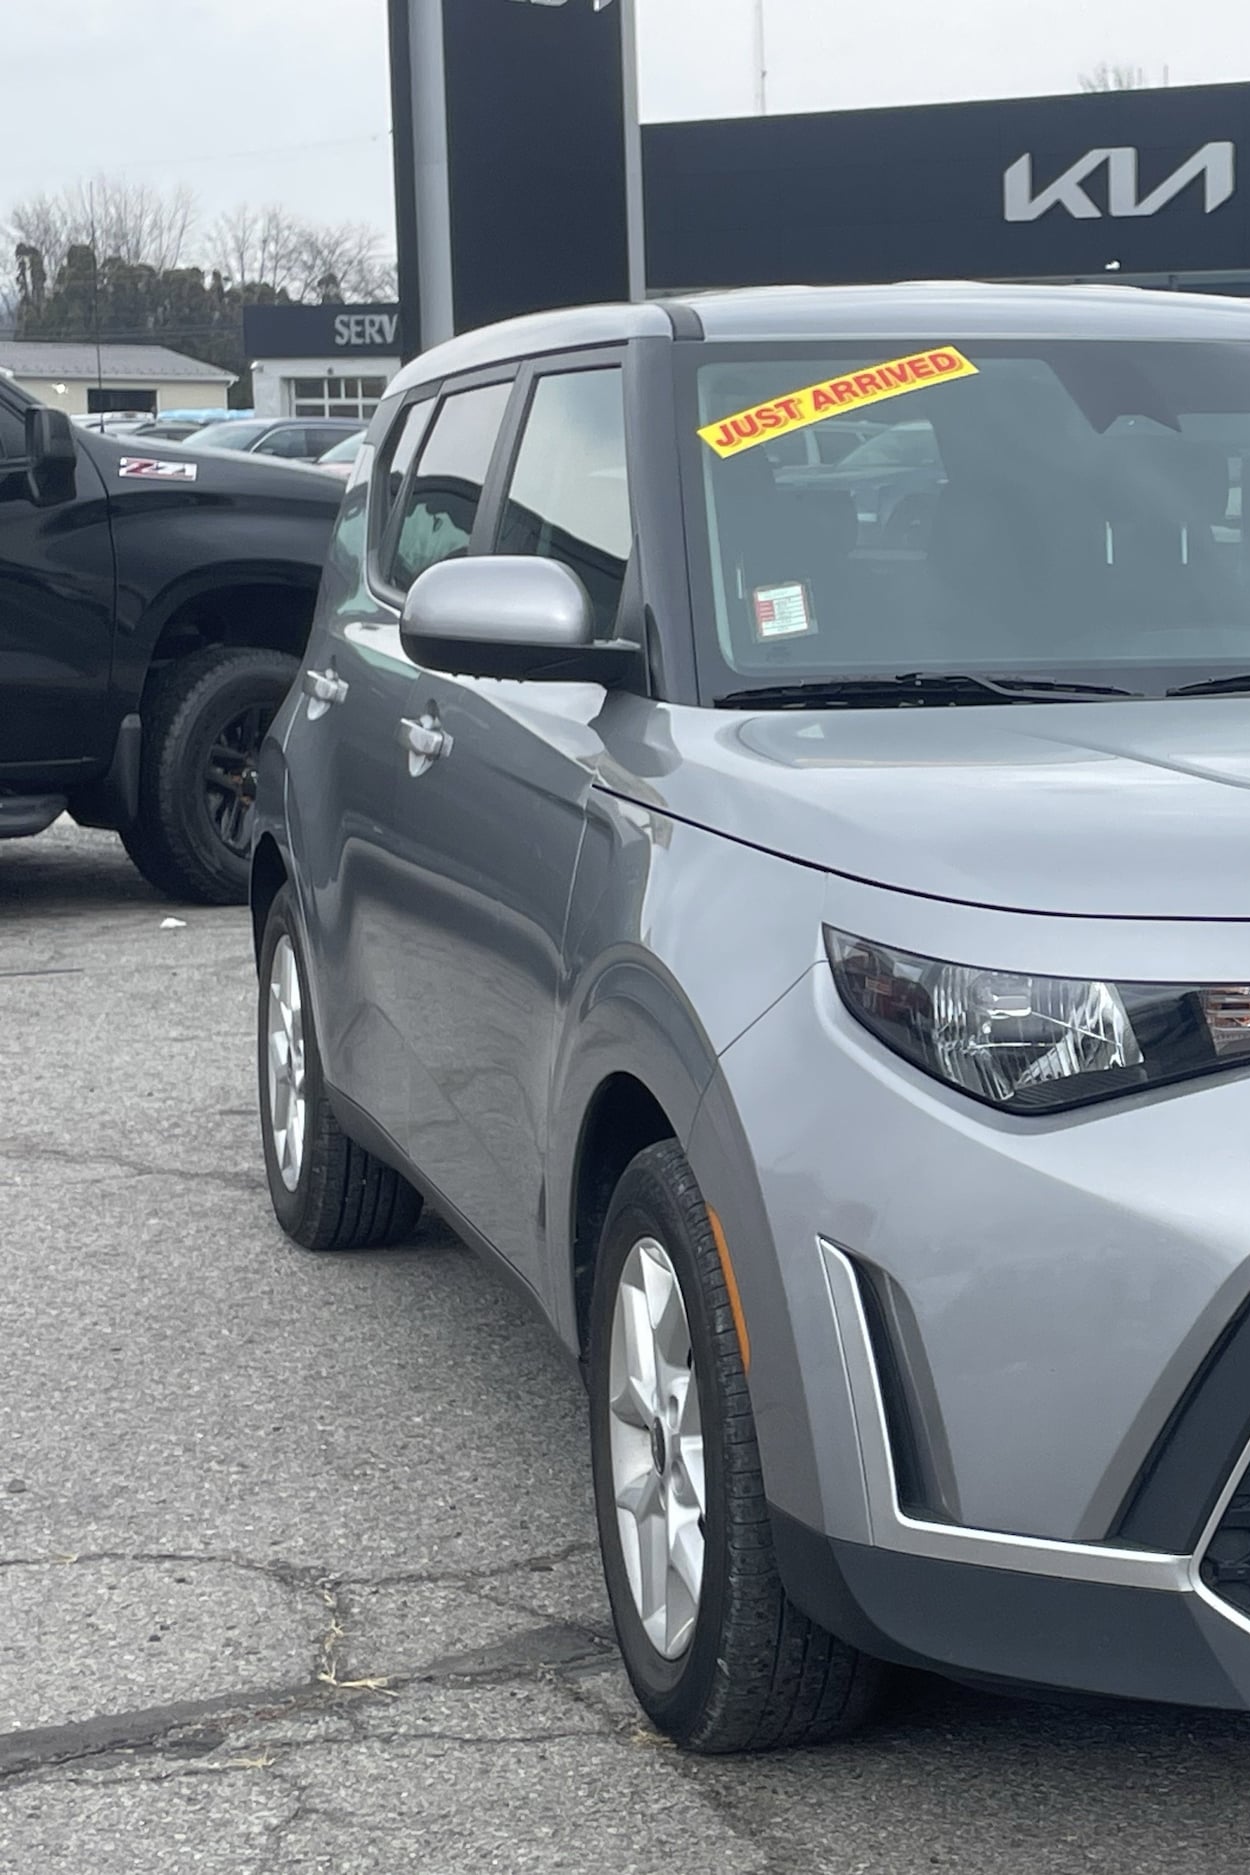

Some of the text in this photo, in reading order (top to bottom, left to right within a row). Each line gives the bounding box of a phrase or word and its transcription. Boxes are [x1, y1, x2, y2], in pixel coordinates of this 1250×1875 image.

[1004, 141, 1234, 222] KIA
[334, 313, 398, 345] SERV
[715, 352, 963, 448] JUST ARRIVED
